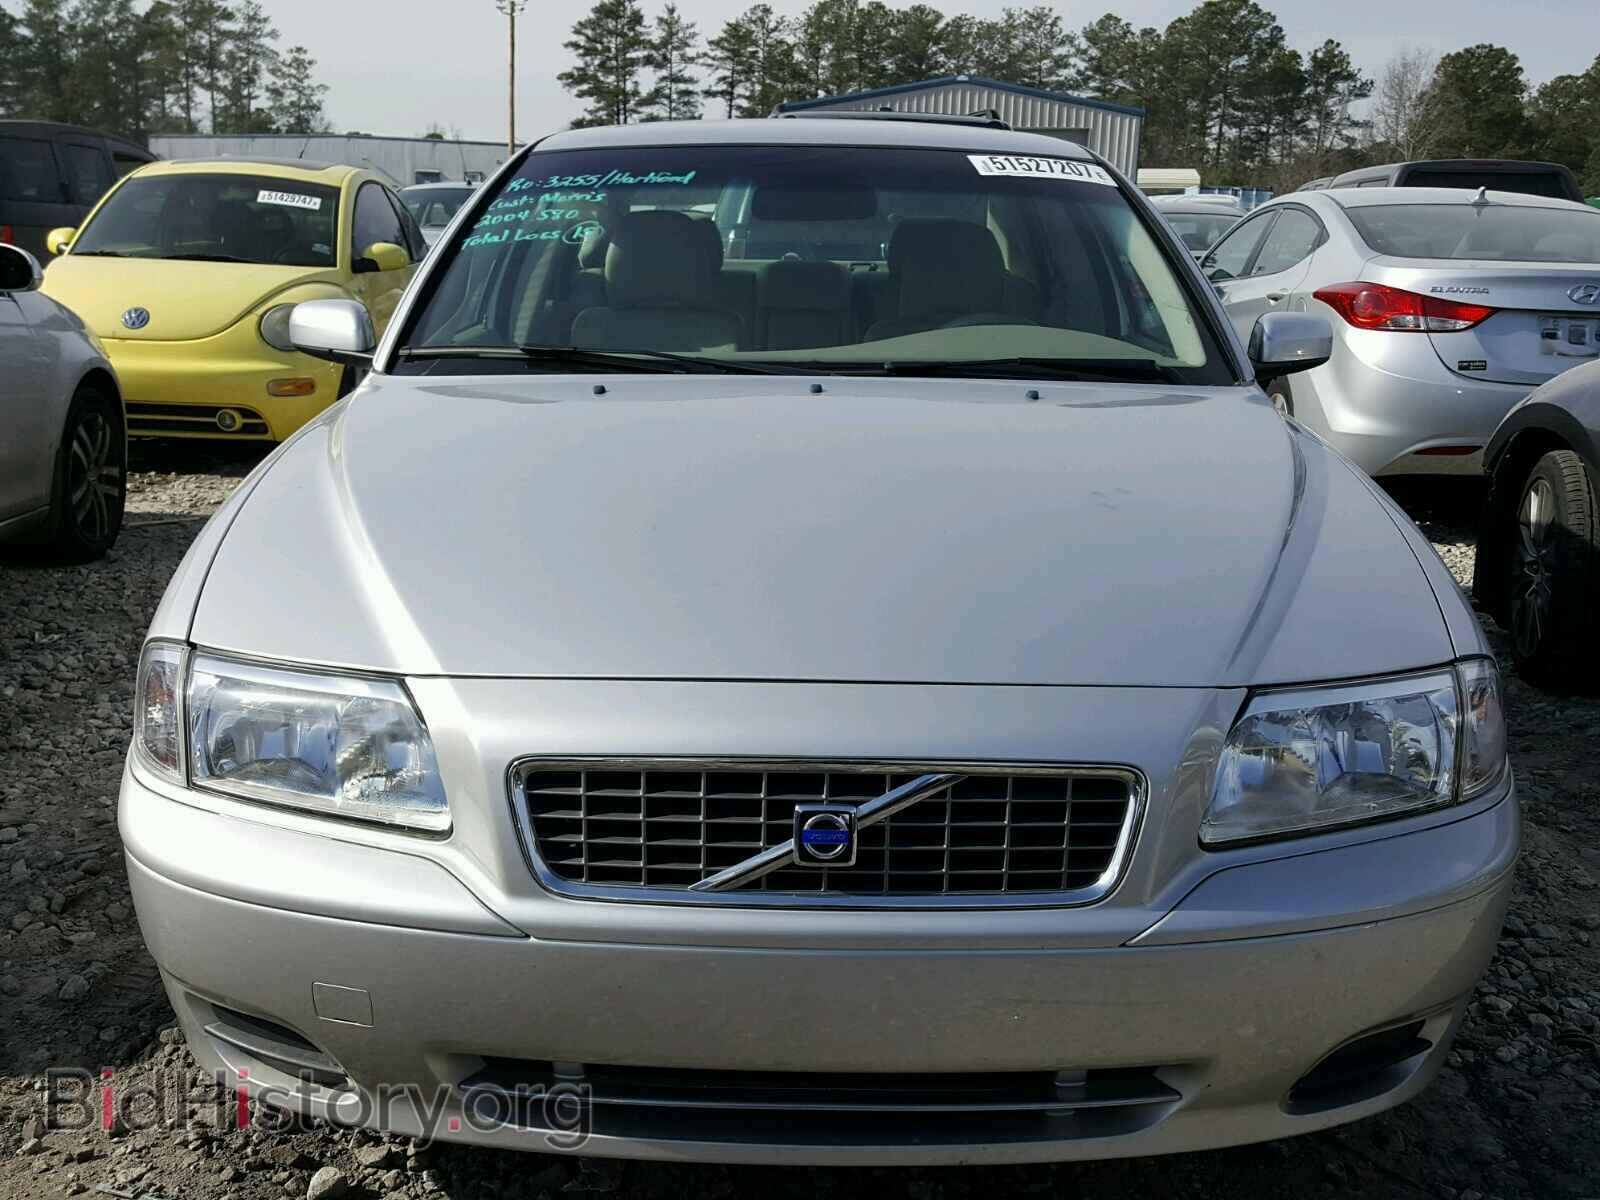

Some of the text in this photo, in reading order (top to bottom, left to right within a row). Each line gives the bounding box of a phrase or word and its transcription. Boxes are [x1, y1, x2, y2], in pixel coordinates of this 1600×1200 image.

[988, 157, 1093, 179] 51527207
[473, 209, 530, 229] 2004
[461, 229, 510, 250] Total
[1430, 286, 1490, 295] ELANTRA
